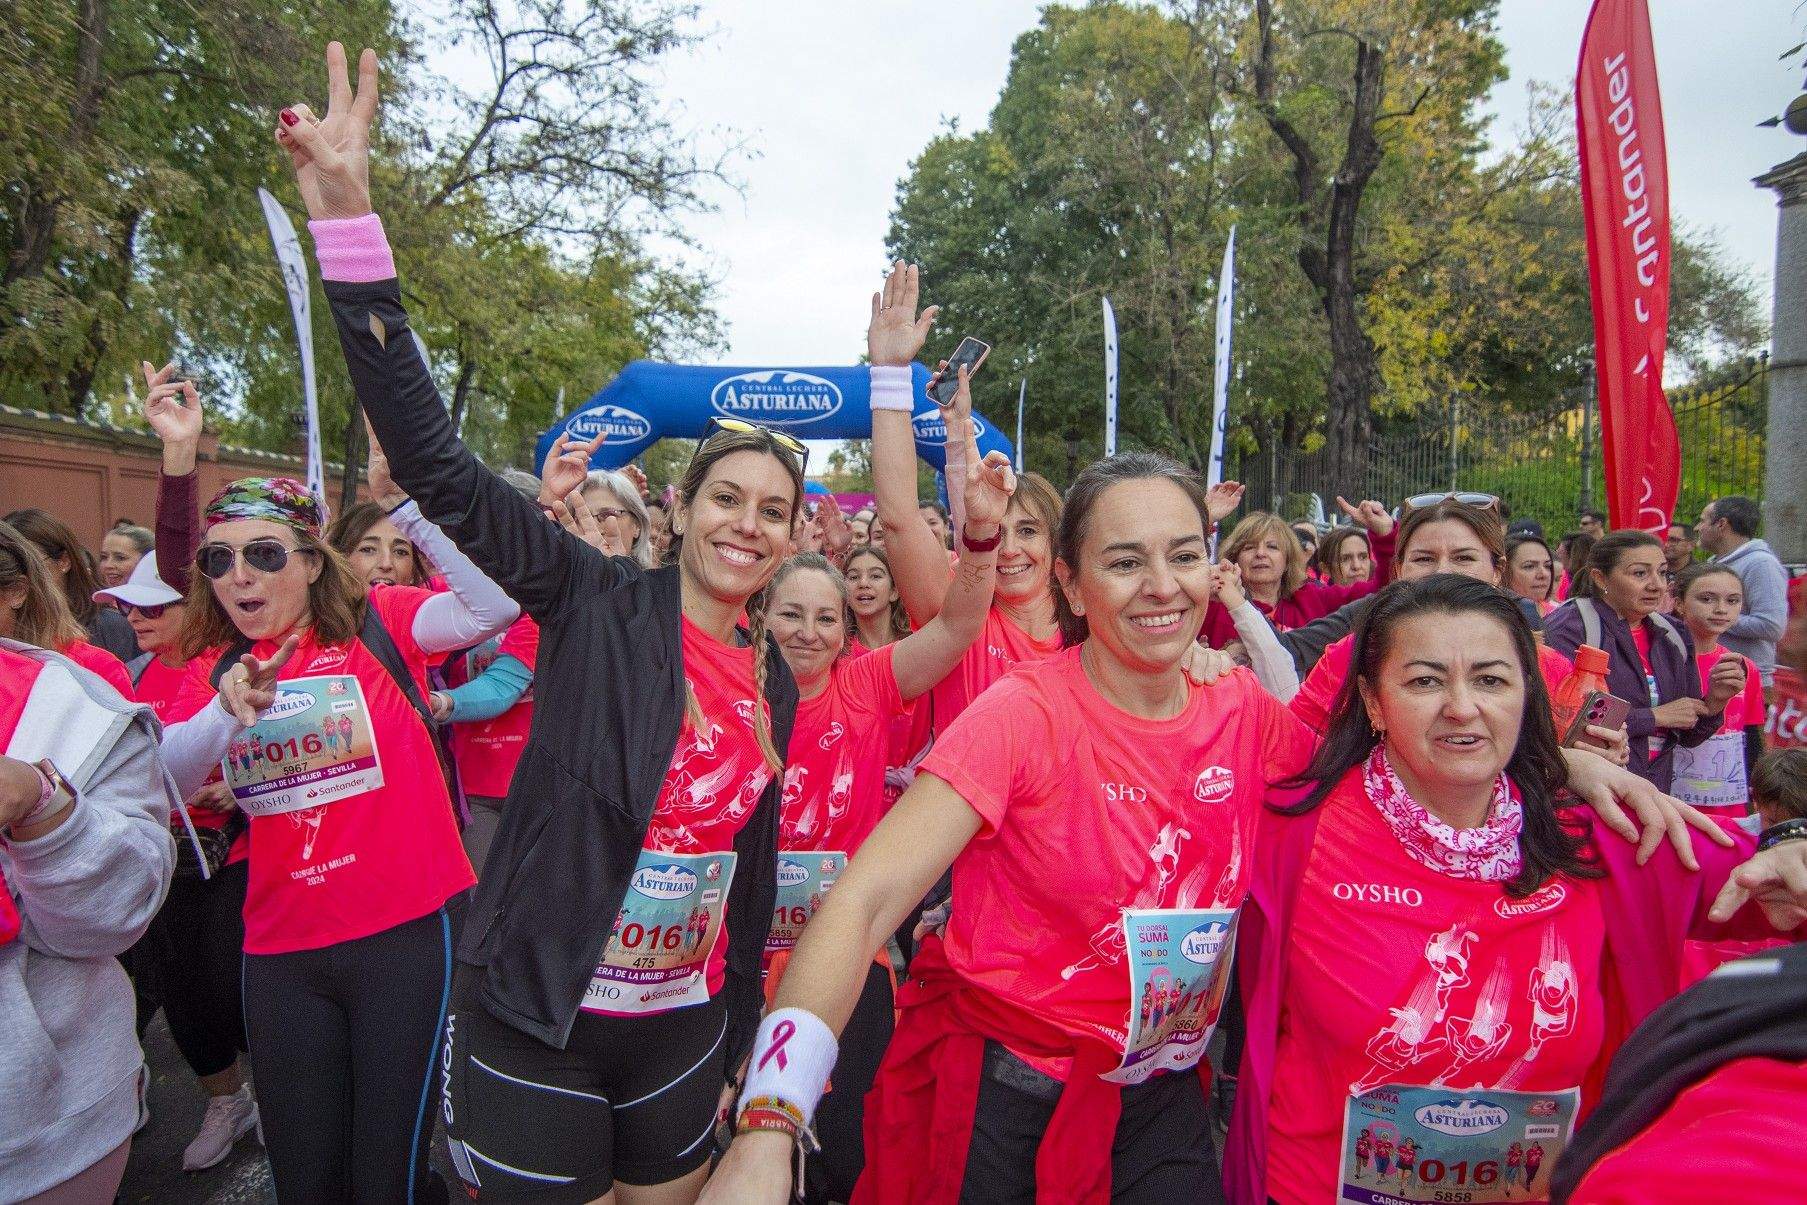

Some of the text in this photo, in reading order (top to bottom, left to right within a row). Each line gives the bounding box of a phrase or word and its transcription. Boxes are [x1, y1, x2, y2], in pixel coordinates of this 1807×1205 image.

[722, 385, 833, 411] ASTURIANA
[572, 419, 644, 436] ASTURIANA
[265, 698, 312, 715] TURIANA
[265, 733, 323, 763] 016
[248, 762, 357, 795] CARRERA DE LA MUJER SEVILLA
[283, 762, 309, 777] 5967
[319, 776, 366, 796] Santander
[251, 794, 291, 811] OYSHO
[317, 863, 329, 874] LA
[329, 854, 357, 870] MUJER
[306, 874, 326, 886] 2024
[634, 872, 694, 892] ASTURIANA
[778, 872, 806, 880] RIANA
[1333, 882, 1423, 907] OYSHO
[1501, 888, 1561, 915] ASTURIANA
[775, 906, 807, 925] 16
[621, 922, 684, 950] 016
[769, 929, 793, 938] 5859
[1138, 932, 1170, 943] SUMA
[1185, 938, 1221, 956] ASTUR
[632, 956, 656, 969] 475
[615, 969, 627, 979] DE
[628, 970, 639, 981] LA
[639, 971, 665, 982] MUJER
[668, 965, 692, 978] SEVILLA
[585, 983, 621, 1001] SHO
[650, 985, 691, 1001] Santander
[442, 1014, 456, 1125] WONG
[1420, 1109, 1503, 1128] ASTURIANA
[1418, 1158, 1500, 1186] 016
[1433, 1190, 1472, 1203] 5858
